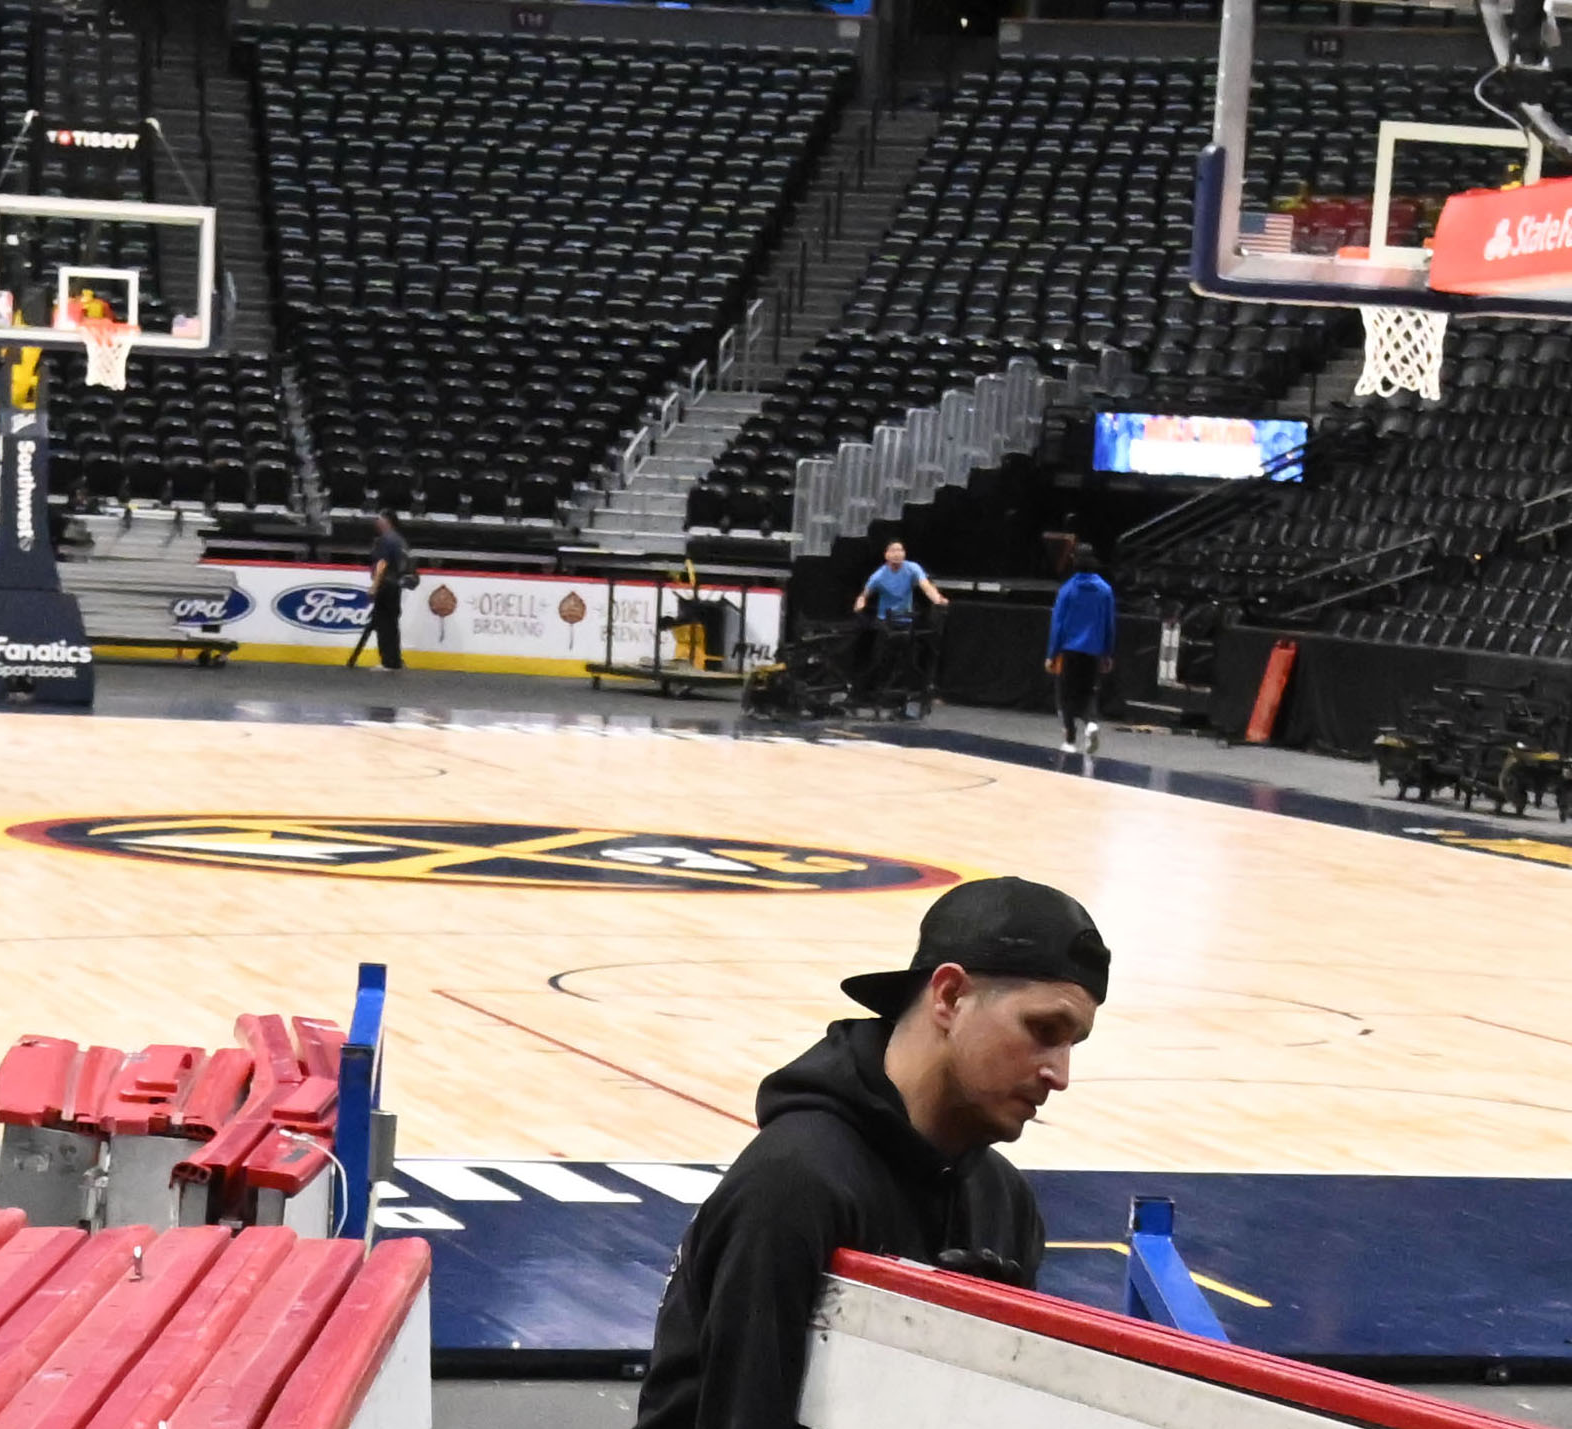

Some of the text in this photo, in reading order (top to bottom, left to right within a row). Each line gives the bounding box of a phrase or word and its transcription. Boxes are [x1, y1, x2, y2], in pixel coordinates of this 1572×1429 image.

[16, 440, 36, 539] Southwest
[173, 594, 228, 619] ord
[296, 589, 374, 625] Ford
[479, 593, 538, 619] ODELL
[473, 618, 543, 638] BREWING
